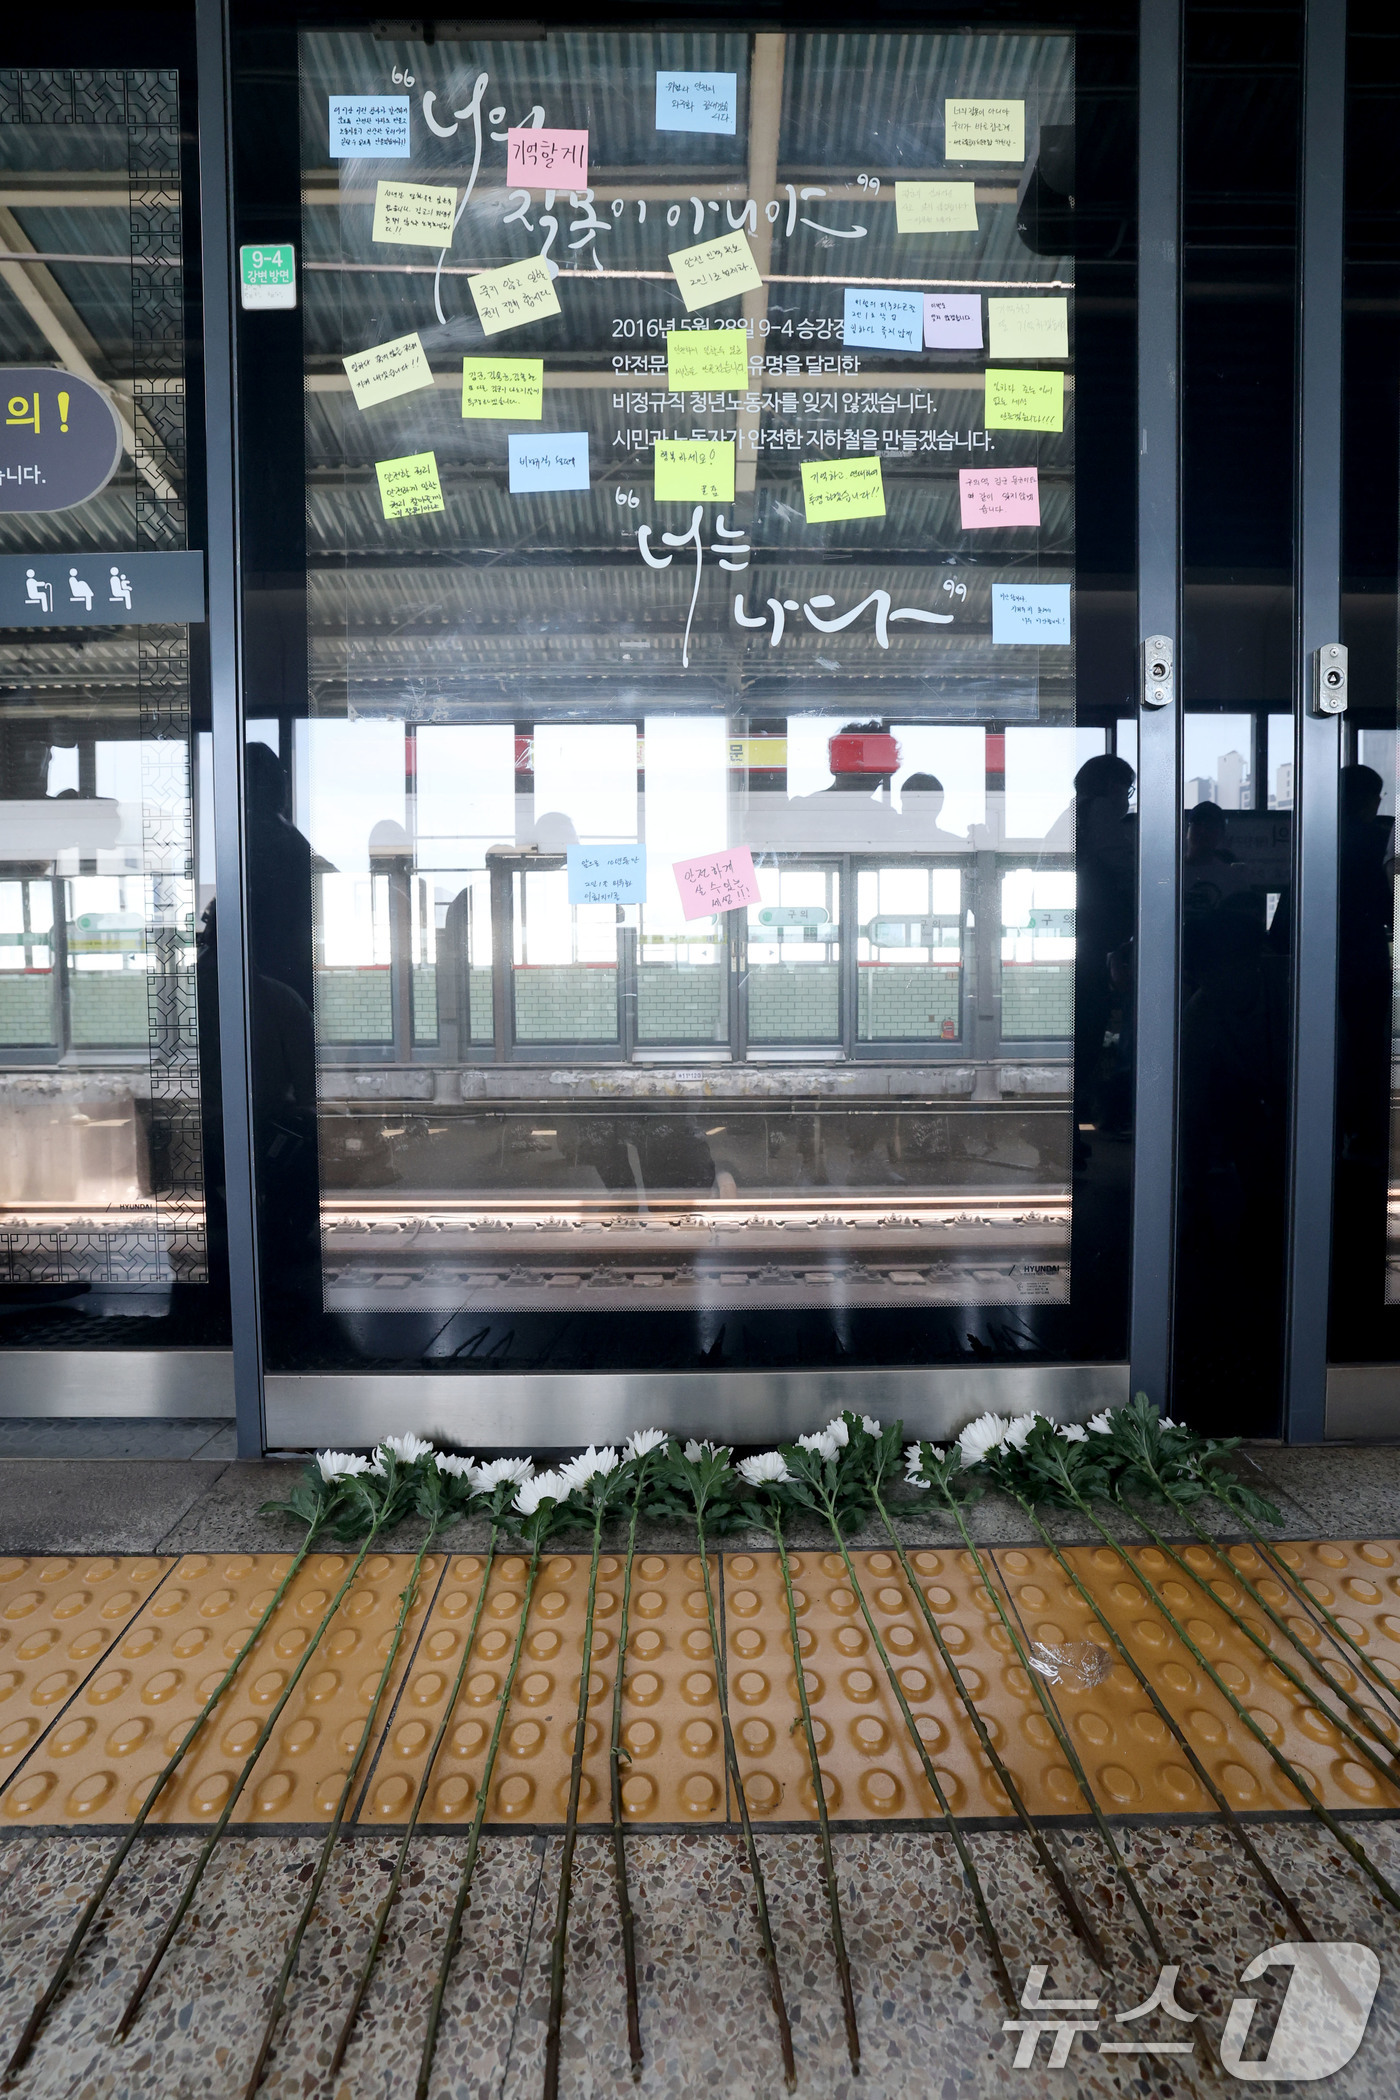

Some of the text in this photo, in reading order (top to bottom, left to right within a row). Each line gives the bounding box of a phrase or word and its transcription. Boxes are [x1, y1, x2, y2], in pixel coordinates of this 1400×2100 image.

[513, 140, 583, 169] 기억할게
[252, 250, 283, 268] 9-4
[247, 269, 289, 283] 강변 방면
[612, 318, 676, 339] 2016년
[758, 319, 793, 338] 9-4
[806, 355, 859, 376] 달리한
[612, 392, 685, 414] 비정규직
[802, 392, 838, 414] 잊지
[842, 392, 938, 414] 않겠습니다.
[747, 428, 803, 450] 안전한
[806, 429, 879, 450] 지하철을
[883, 429, 995, 451] 만들겠습니다.
[684, 859, 734, 883] 안전하게
[1024, 1265, 1060, 1273] HYUNDAI
